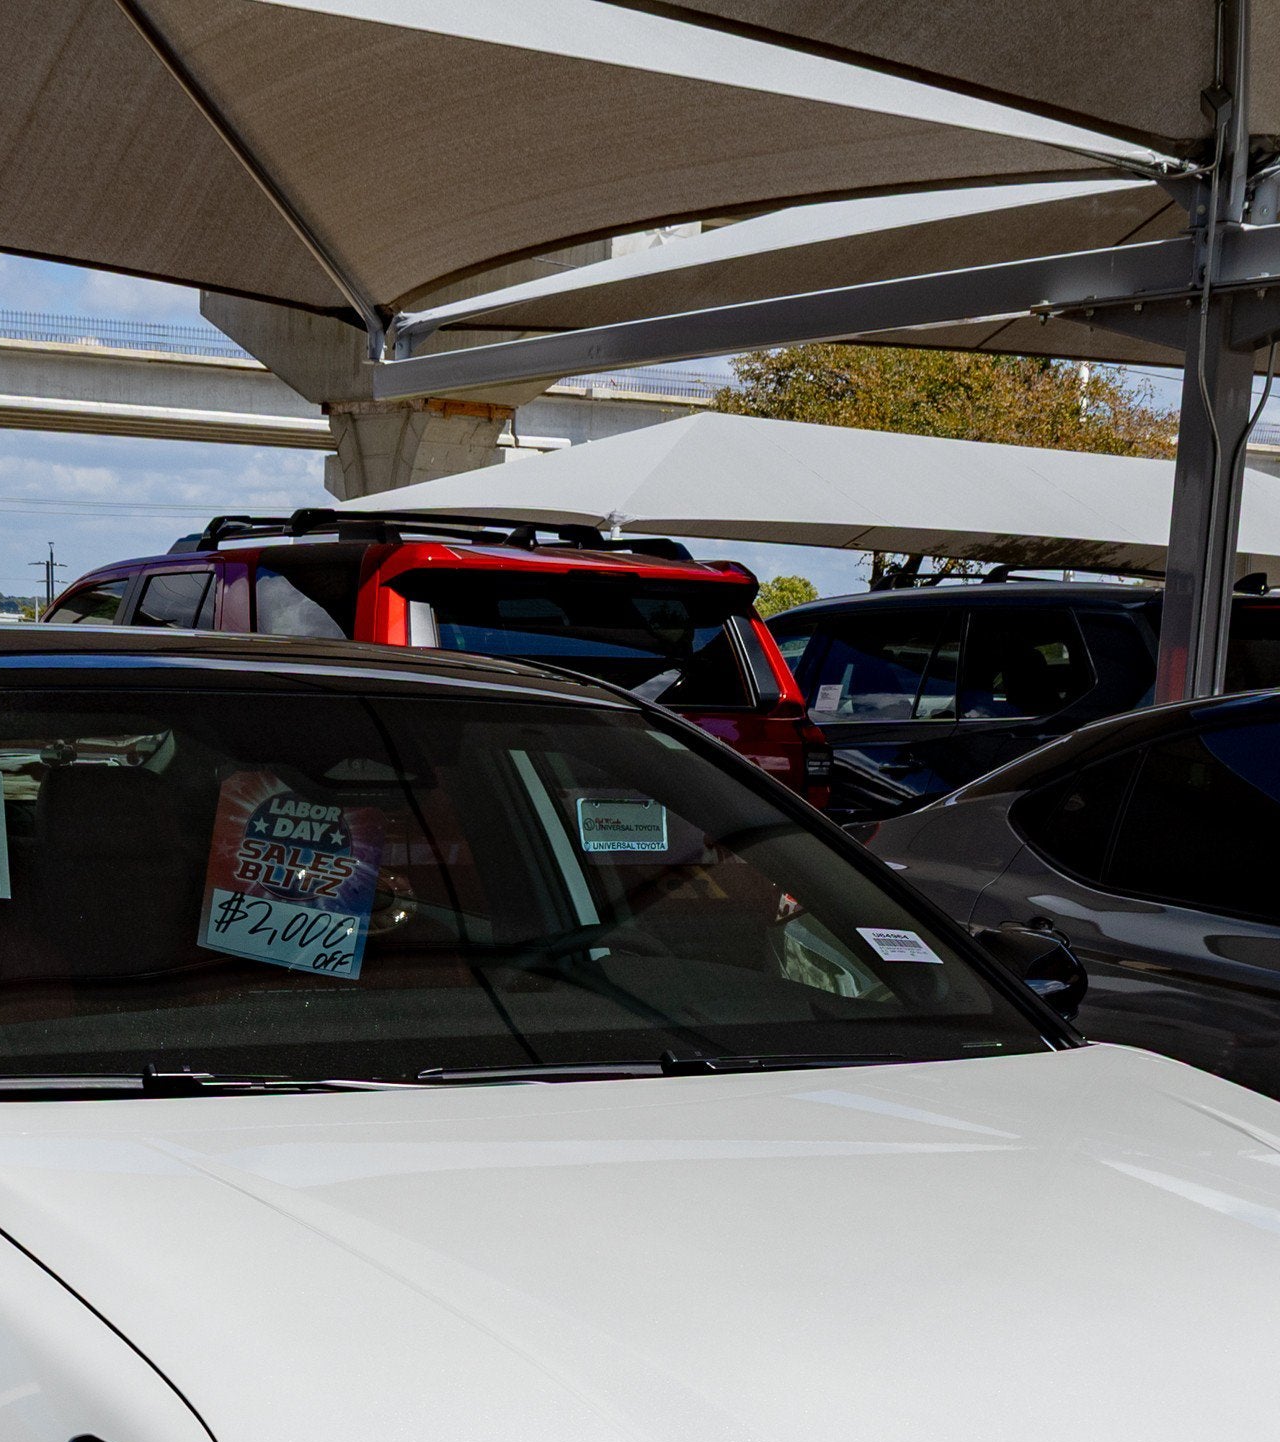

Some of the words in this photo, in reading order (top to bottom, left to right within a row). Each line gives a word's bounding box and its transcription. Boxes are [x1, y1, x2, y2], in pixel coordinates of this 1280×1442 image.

[269, 798, 341, 822] LABOR
[272, 818, 331, 842] DAY
[595, 824, 634, 832] UNIVERSAL
[635, 824, 661, 832] TOYOTA
[593, 842, 634, 850] UNIVERSAL
[636, 842, 666, 850] TOYOTA
[238, 838, 360, 879] SALES
[234, 858, 345, 898] BLITZ
[214, 890, 357, 950] $2,000
